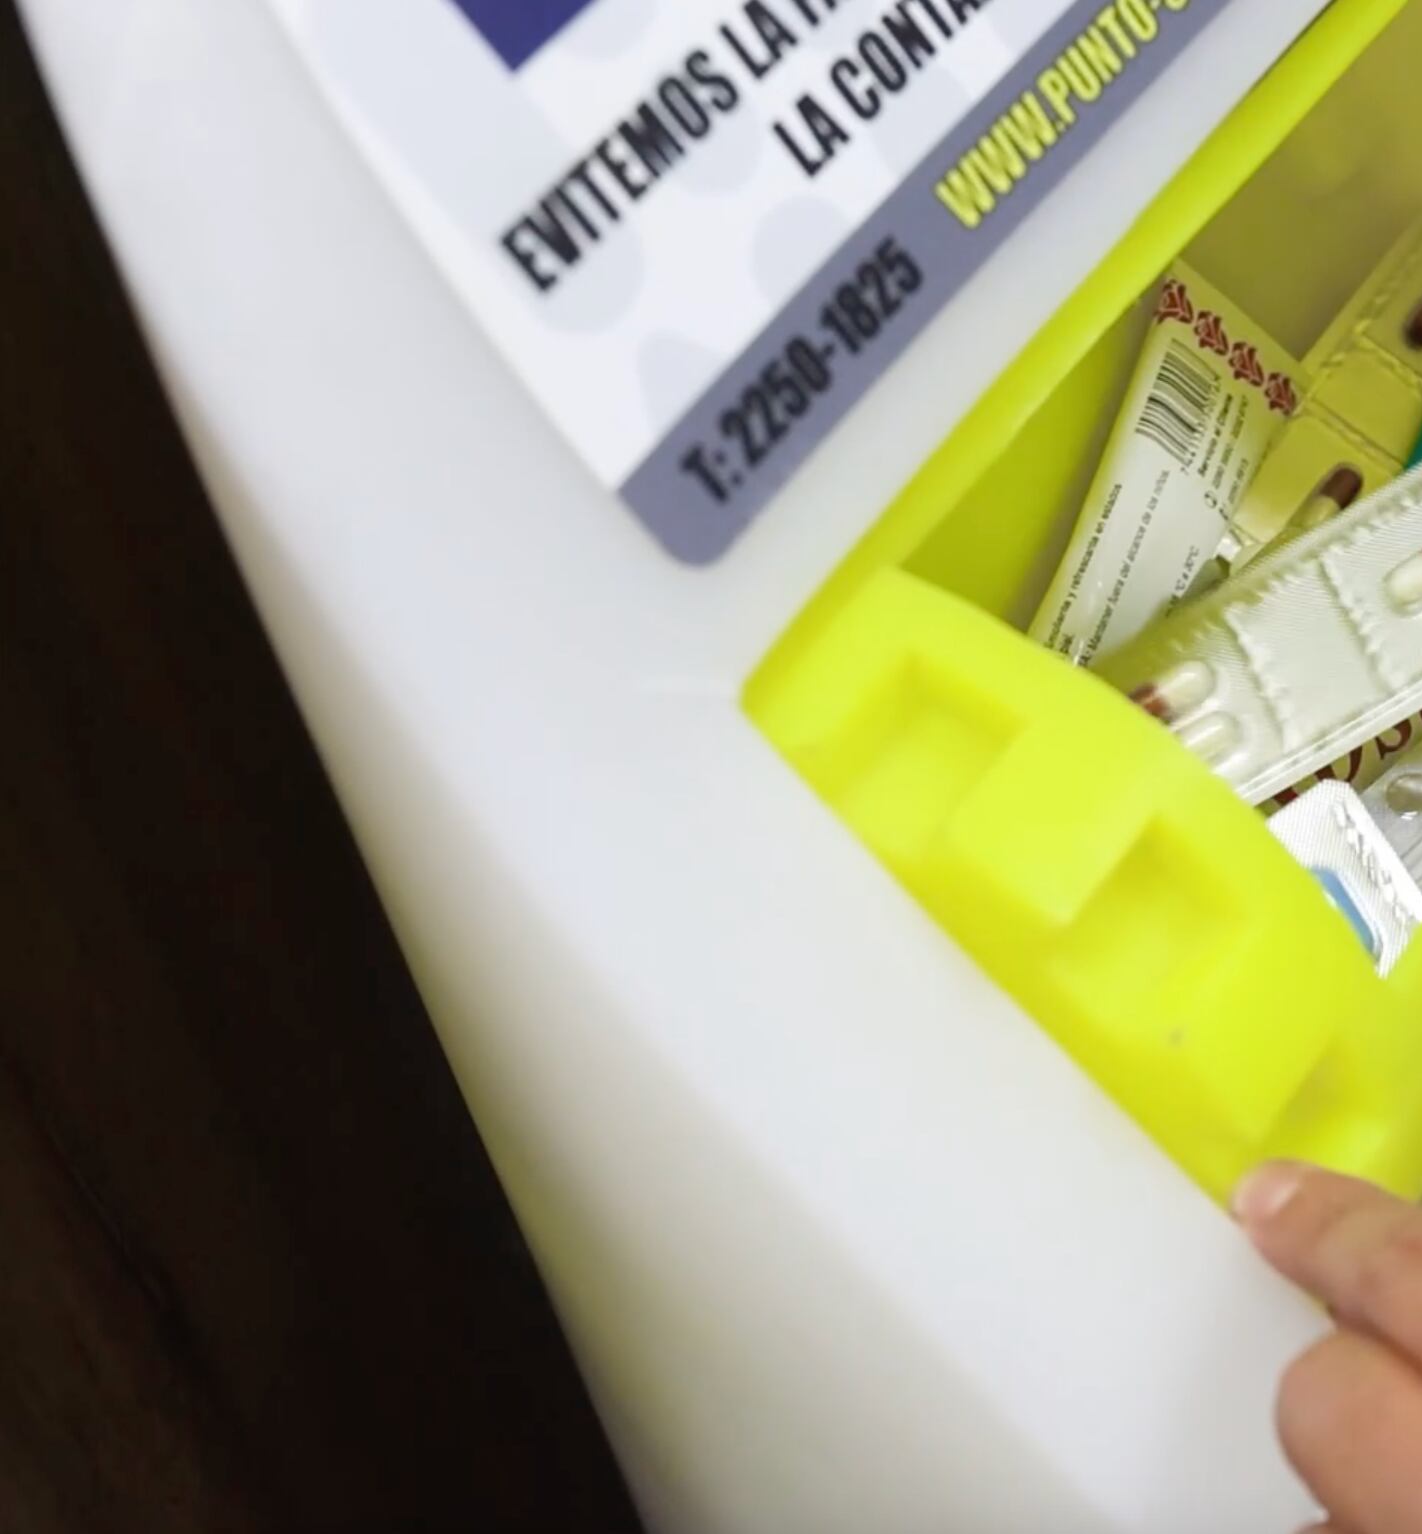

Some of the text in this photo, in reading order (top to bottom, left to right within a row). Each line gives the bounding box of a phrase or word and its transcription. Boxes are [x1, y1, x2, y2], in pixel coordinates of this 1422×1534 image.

[500, 0, 799, 292] EVITEMOS LA
[773, 94, 850, 178] LA
[680, 438, 743, 506] T:
[718, 236, 925, 469] 2250-1825
